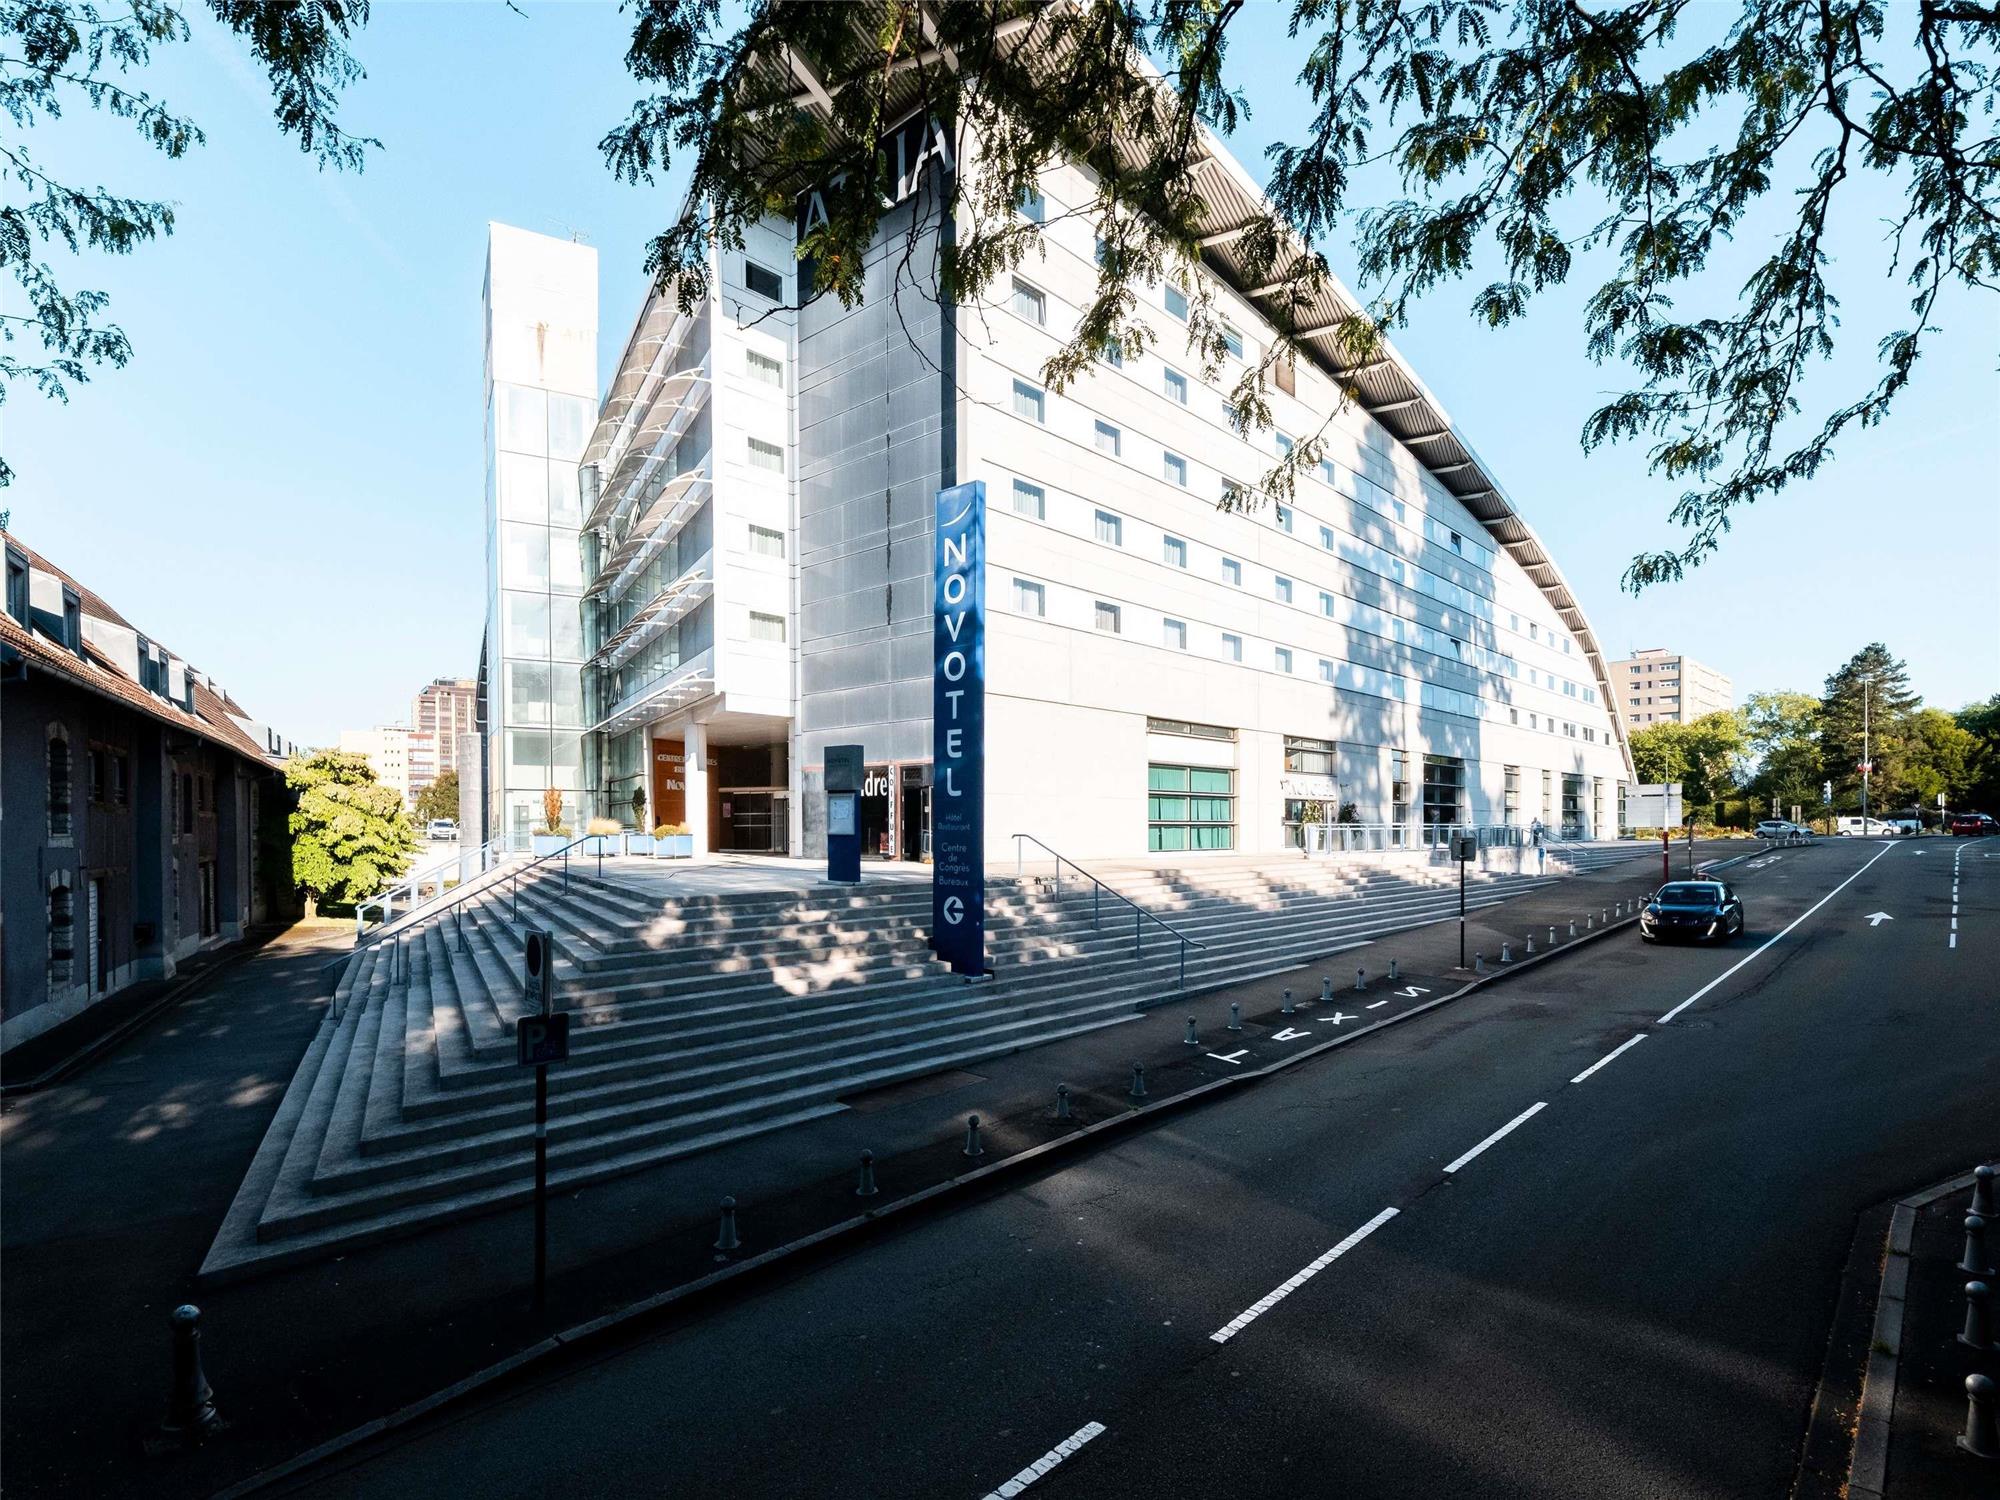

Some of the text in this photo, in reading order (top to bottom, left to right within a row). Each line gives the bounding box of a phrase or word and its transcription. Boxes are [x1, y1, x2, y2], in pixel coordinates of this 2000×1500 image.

[944, 533, 966, 797] NOVOTEL
[941, 842, 967, 852] Centre
[947, 854, 958, 862] de
[938, 862, 971, 874] Congrès
[938, 875, 969, 886] Bureaux
[1206, 986, 1431, 1064] TAXIS
